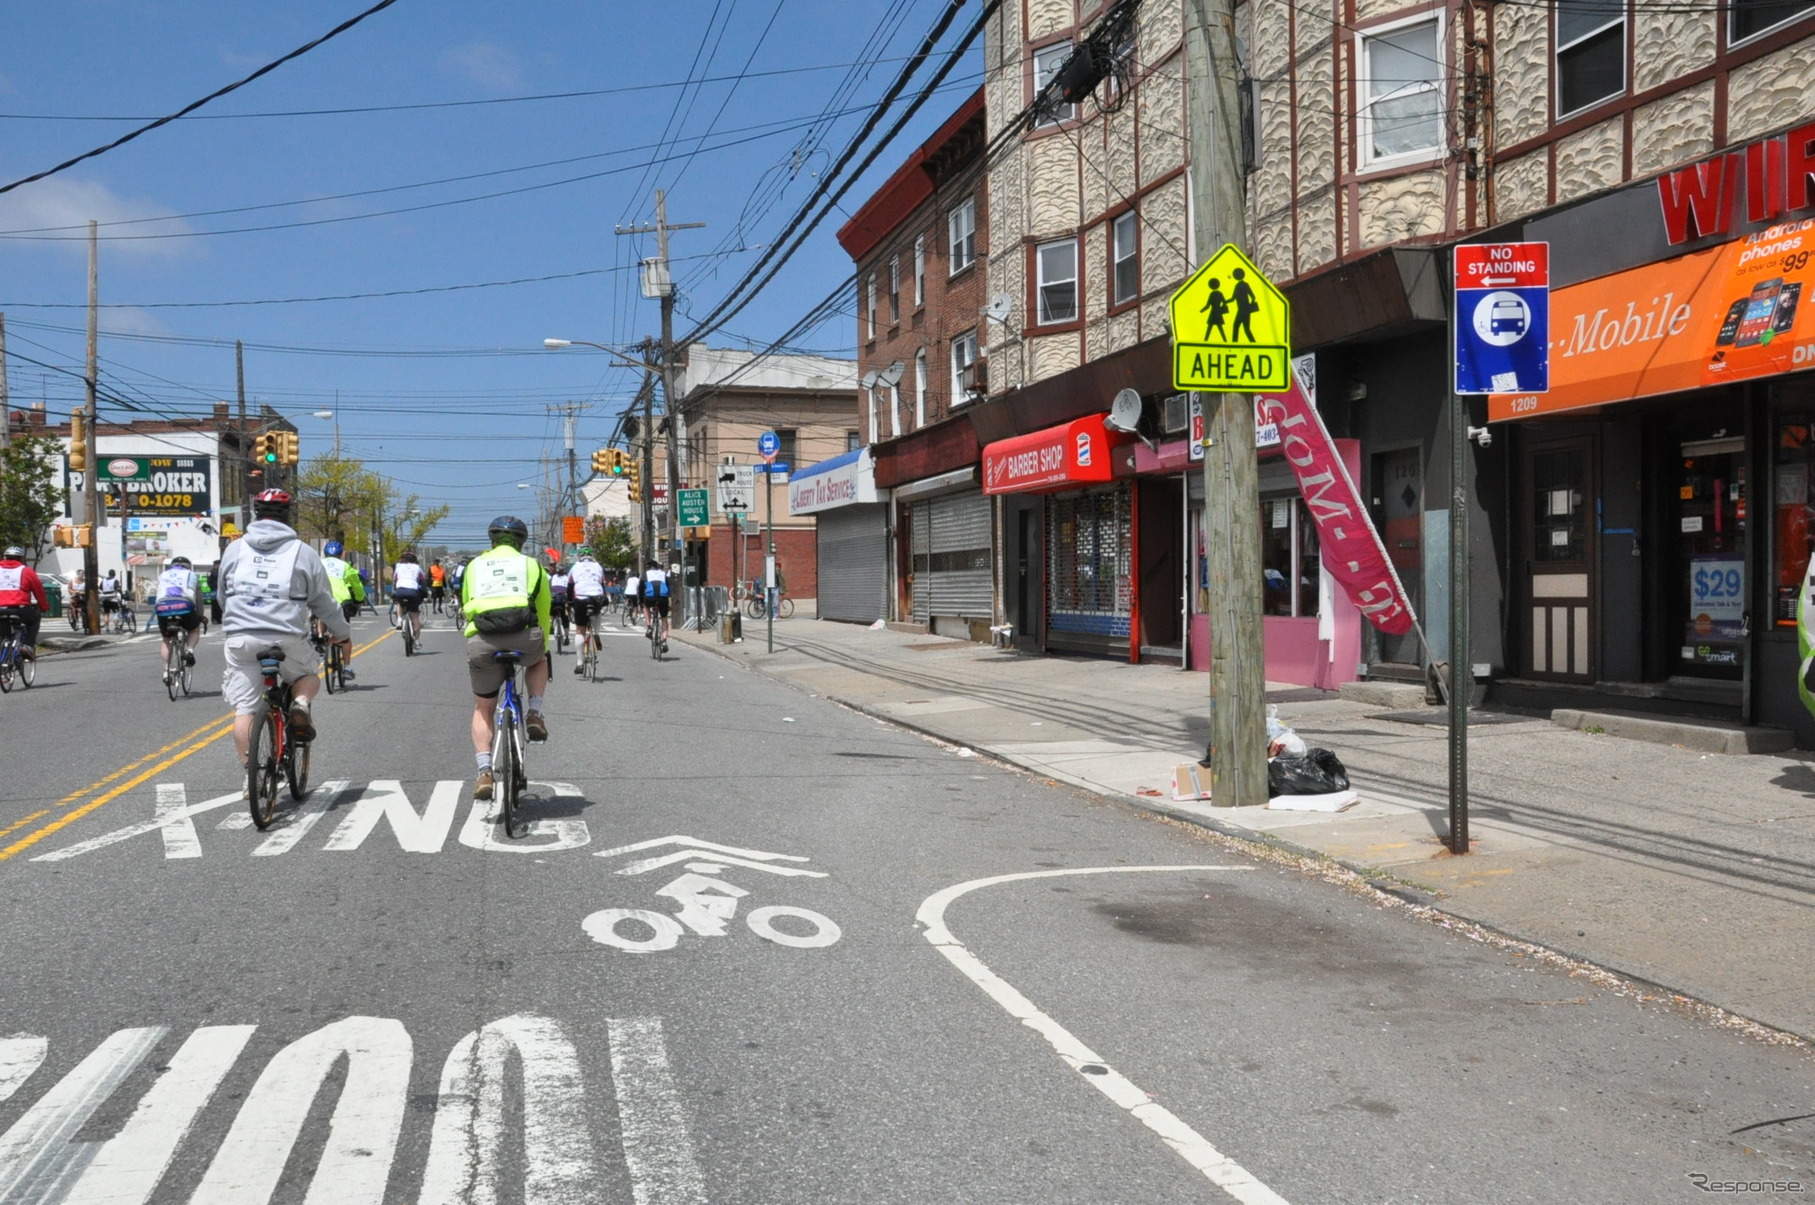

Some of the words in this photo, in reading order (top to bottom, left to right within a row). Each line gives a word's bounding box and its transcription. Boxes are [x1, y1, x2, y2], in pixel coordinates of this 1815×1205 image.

[1491, 248, 1513, 260] NO
[1738, 234, 1802, 267] phones
[1468, 261, 1536, 275] STANDING
[1736, 266, 1746, 276] as
[1747, 263, 1764, 275] low
[1766, 260, 1777, 270] as
[1191, 352, 1273, 380] AHEAD
[1511, 396, 1538, 413] 1209
[1008, 450, 1039, 479] BARBER
[1040, 444, 1063, 473] SHOP
[681, 498, 705, 506] AUSTEN
[684, 491, 702, 499] ALICE
[1694, 566, 1741, 600] $29
